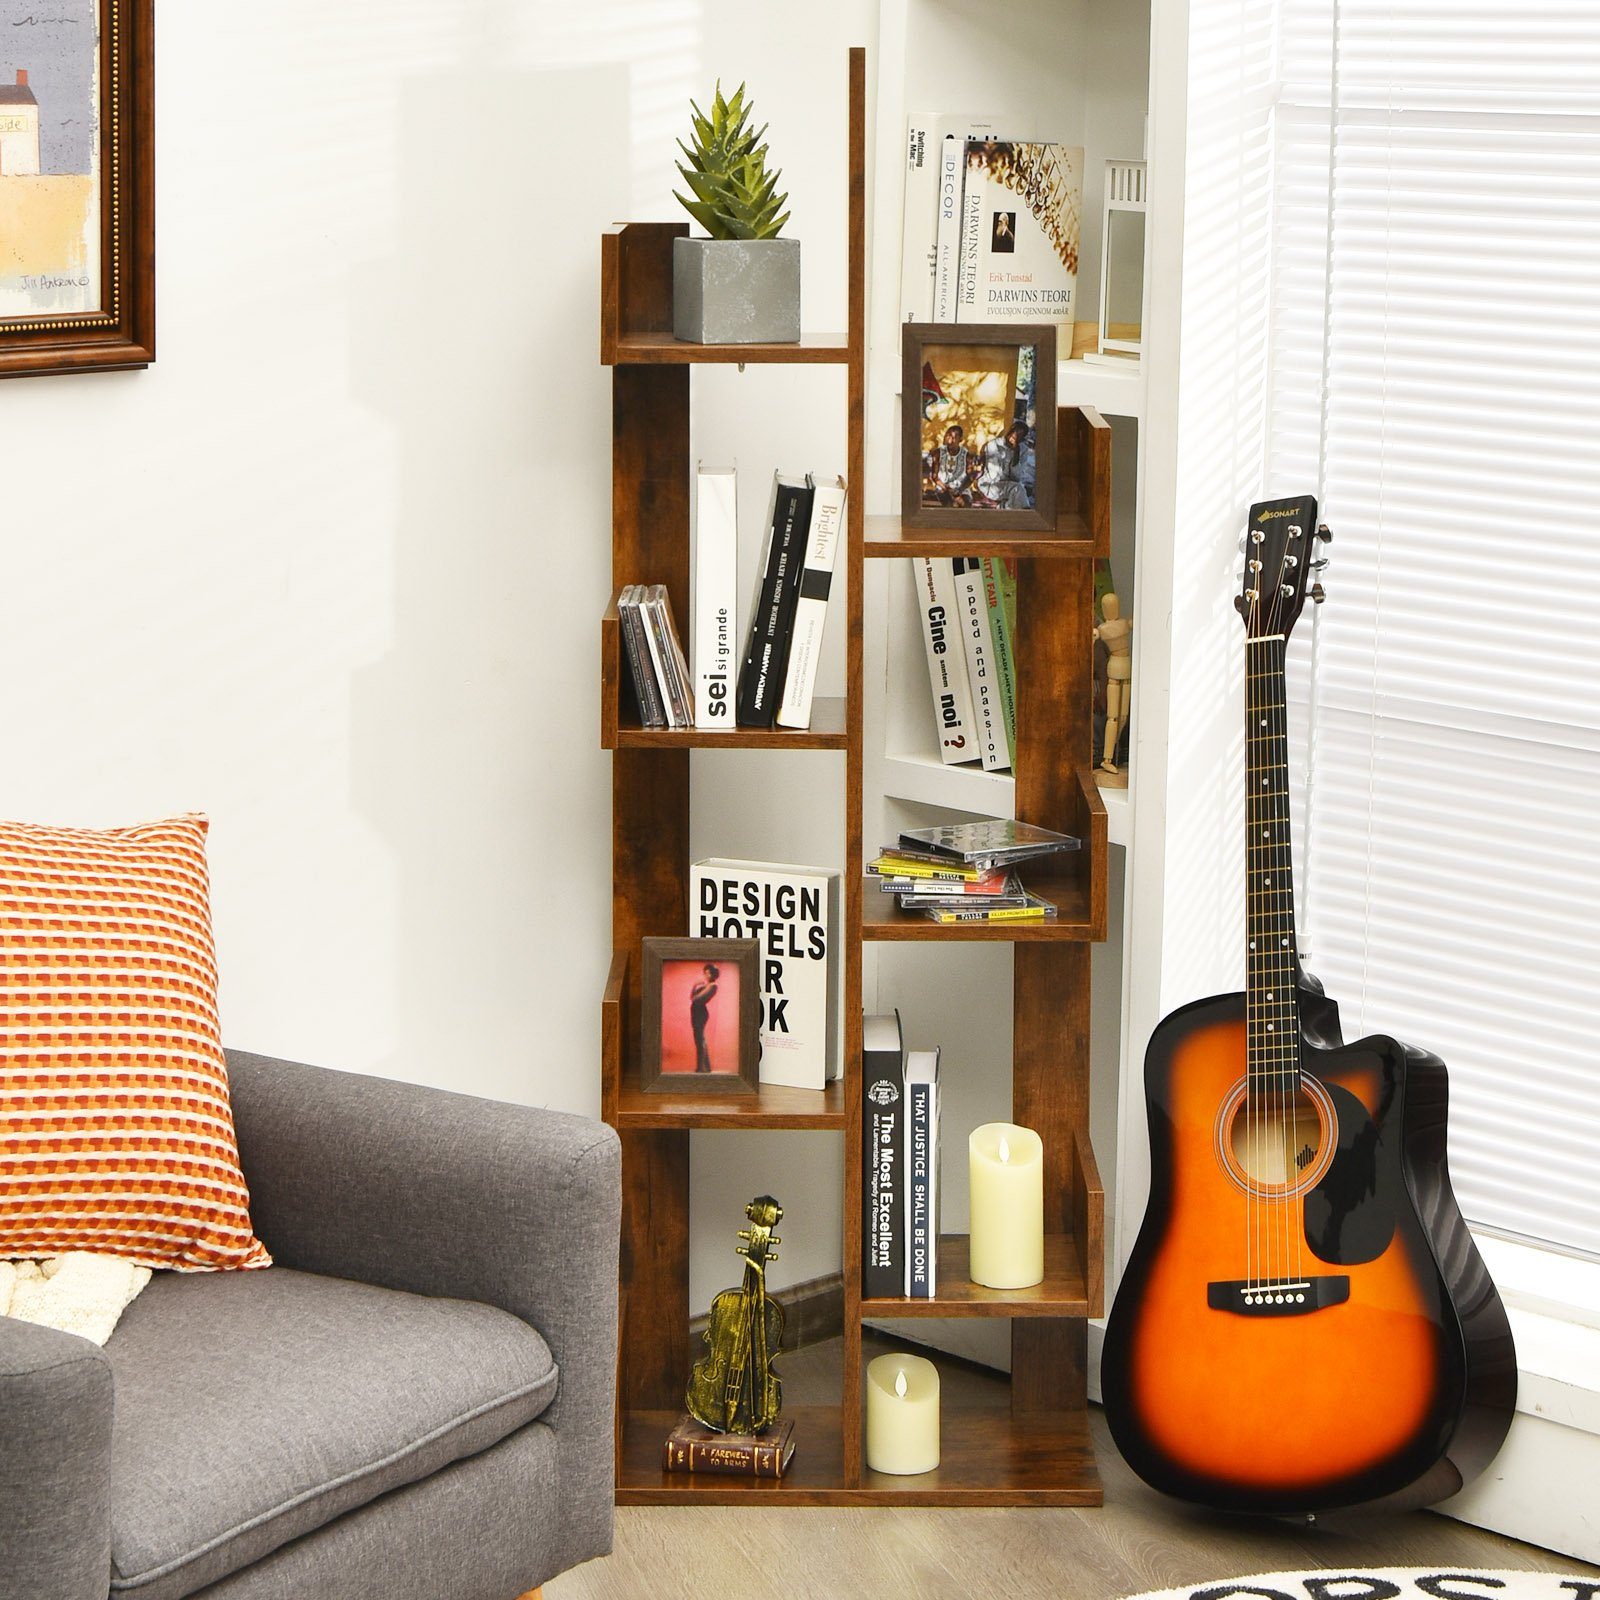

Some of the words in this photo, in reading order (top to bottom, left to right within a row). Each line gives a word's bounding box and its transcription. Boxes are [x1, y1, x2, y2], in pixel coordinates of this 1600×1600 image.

[916, 131, 925, 168] Switching
[944, 162, 955, 219] DECOR
[968, 195, 980, 259] DARWINS
[965, 263, 976, 304] TEORI
[989, 272, 1004, 282] Erik
[1006, 273, 1033, 282] Tunstad
[988, 290, 1038, 302] DARWINS
[1040, 290, 1071, 302] TEORI
[1269, 508, 1300, 518] SONART
[782, 524, 793, 547] VOLUME
[814, 504, 838, 560] Brightest
[777, 552, 788, 577] REVIEW
[772, 579, 784, 603] DESIGN
[926, 567, 936, 602] Dungaciu
[767, 605, 780, 636] INTERIOR
[966, 584, 980, 638] speed
[987, 582, 997, 608] FAIR
[999, 644, 1008, 671] DECADE
[716, 607, 730, 654] grande
[928, 606, 947, 654] Cine
[716, 659, 727, 670] si
[975, 646, 986, 677] and
[704, 674, 727, 718] sei
[754, 675, 768, 710] ANDREW
[941, 694, 961, 729] noi
[980, 686, 996, 762] passion
[944, 734, 966, 749] ?
[700, 878, 820, 922] DESIGN
[914, 1092, 925, 1123] THAT
[880, 1113, 895, 1143] The
[880, 1148, 894, 1188] Most
[914, 1126, 925, 1177] JUSTICE
[870, 1170, 880, 1198] Tragedy
[914, 1184, 925, 1224] SHALL
[879, 1192, 894, 1267] Excellent
[914, 1228, 924, 1245] BE
[914, 1249, 924, 1282] DONE
[701, 1448, 705, 1456] A
[710, 1448, 750, 1459] FAREWELL
